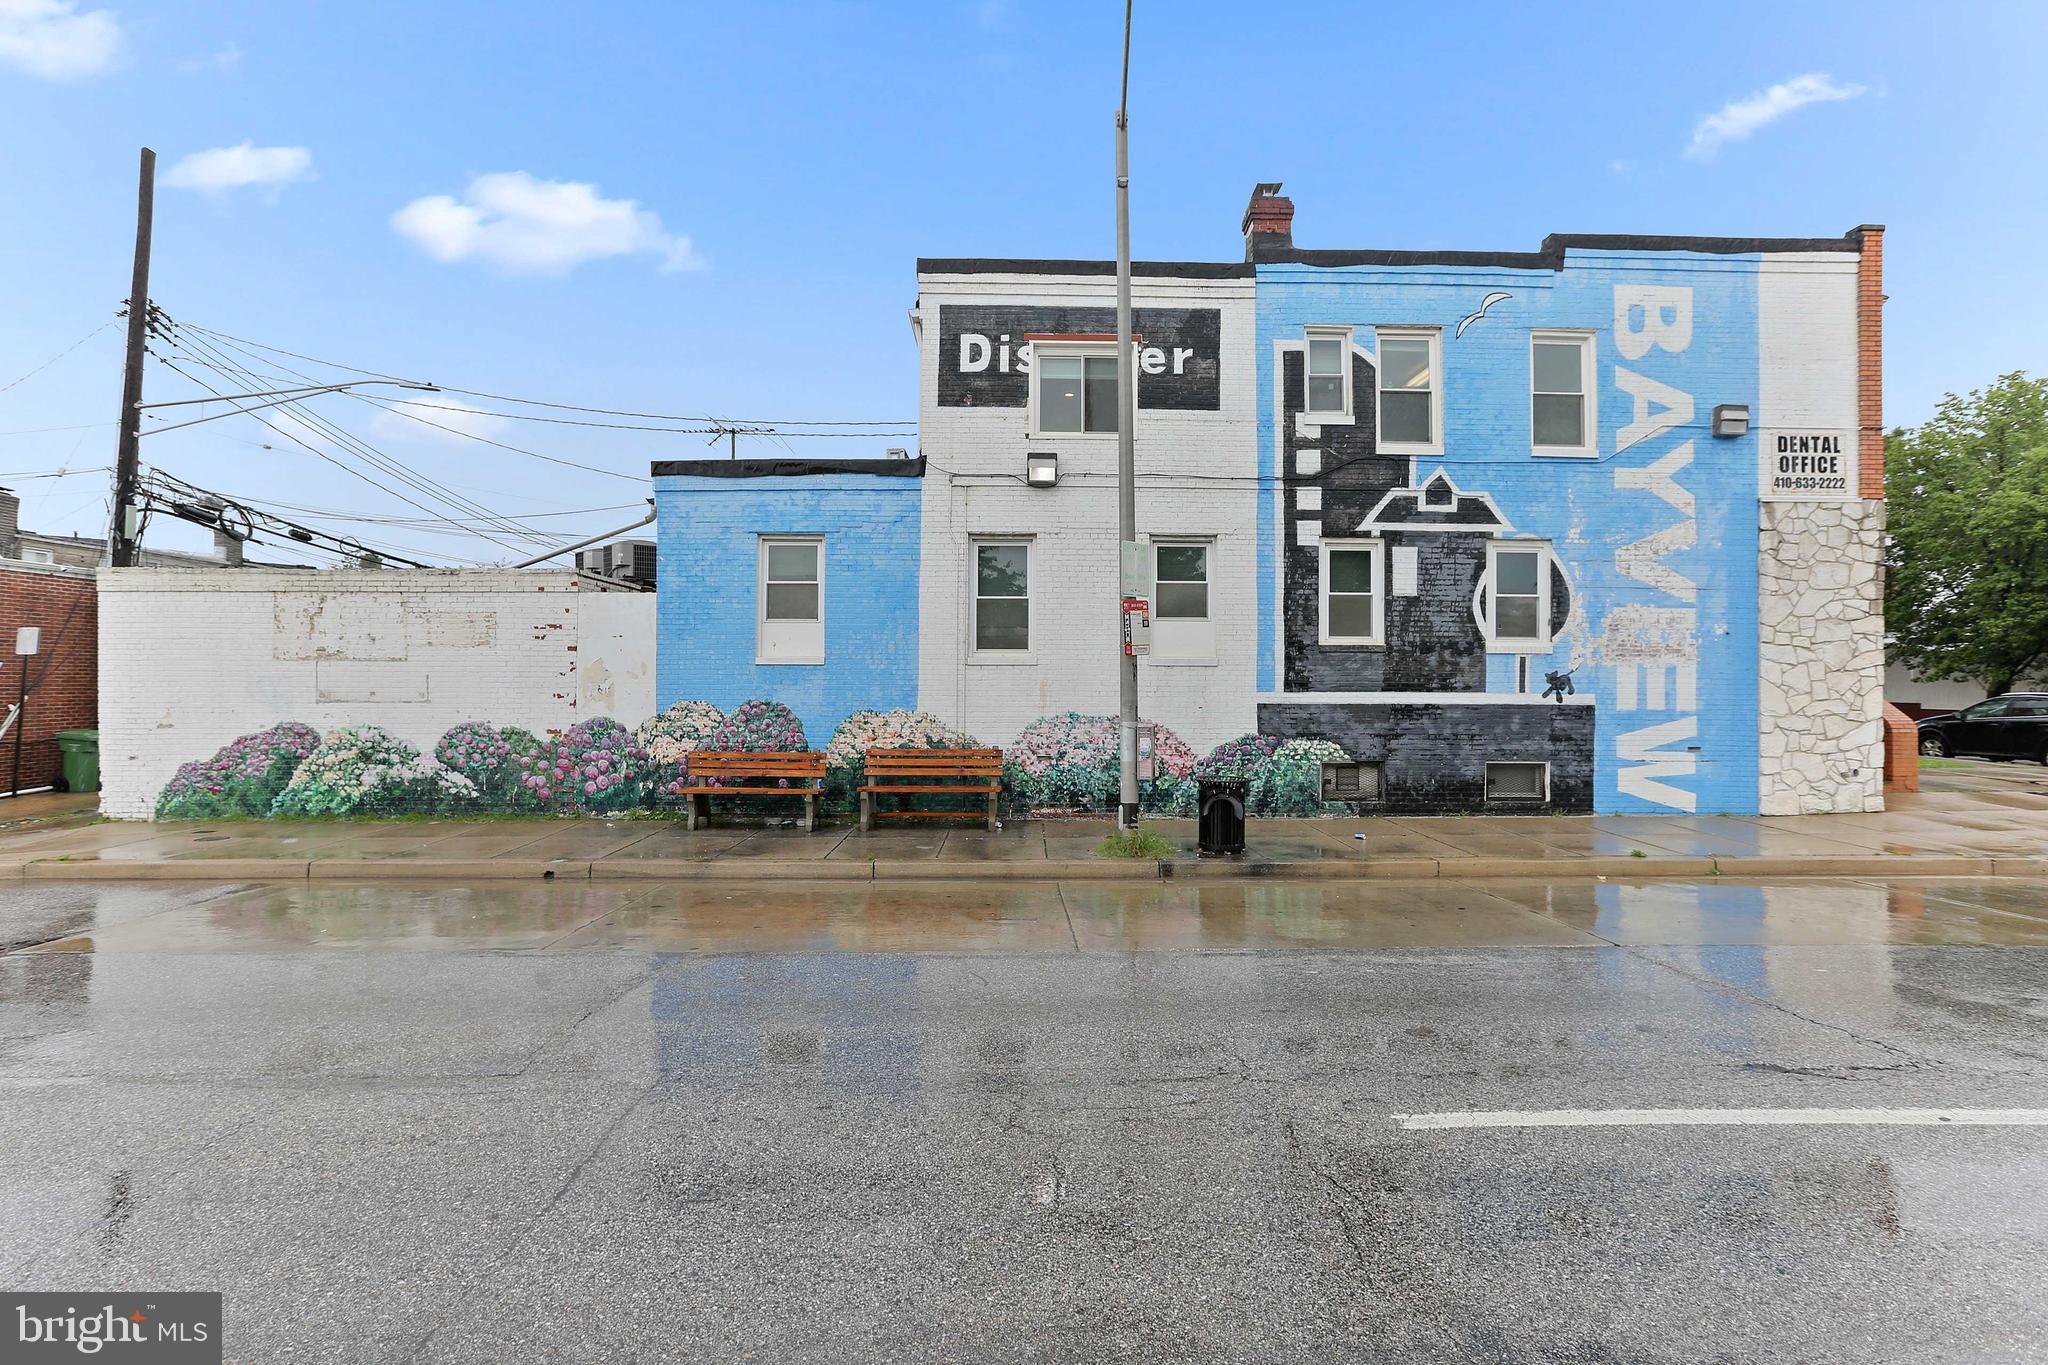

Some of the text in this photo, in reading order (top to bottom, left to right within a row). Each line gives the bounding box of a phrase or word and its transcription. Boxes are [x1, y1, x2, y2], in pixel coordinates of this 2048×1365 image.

[1777, 436, 1841, 453] DENTAL
[1779, 456, 1838, 473] OFFICE
[1773, 477, 1846, 489] 410-633-2222
